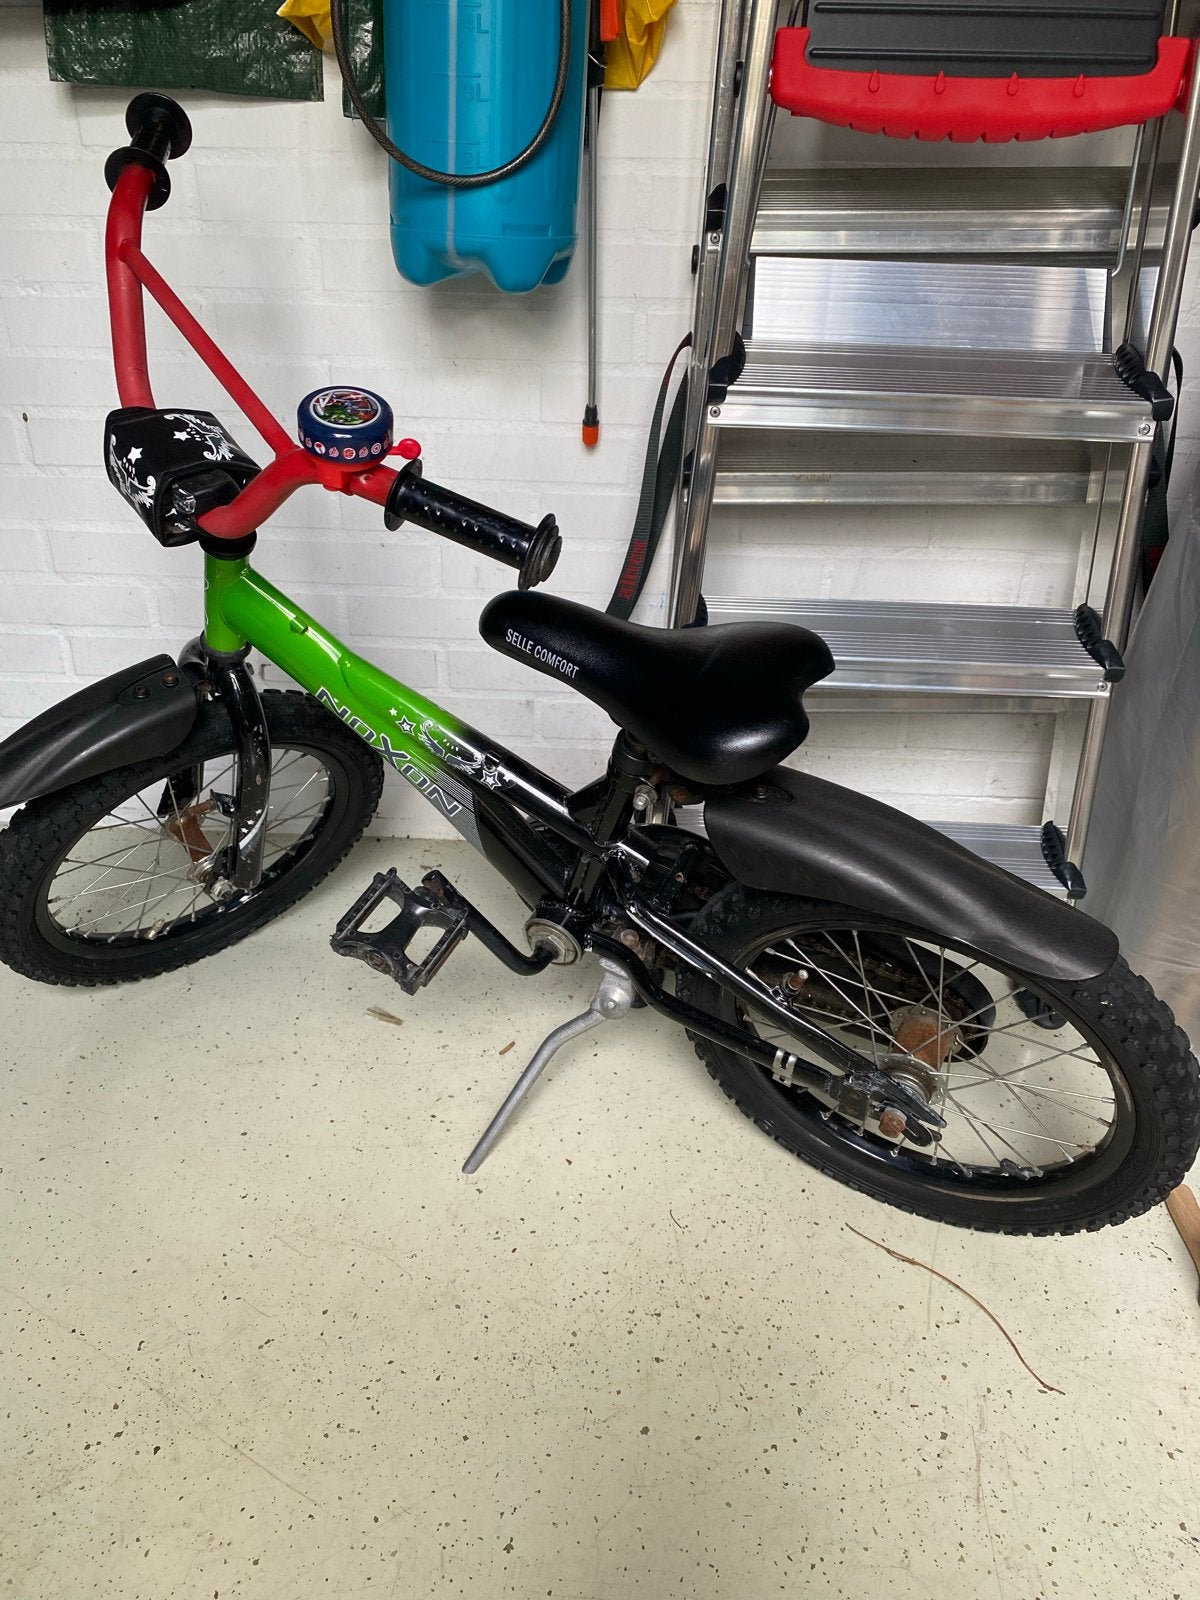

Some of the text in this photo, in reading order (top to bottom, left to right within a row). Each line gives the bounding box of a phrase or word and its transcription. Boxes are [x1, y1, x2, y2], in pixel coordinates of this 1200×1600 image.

[463, 13, 490, 34] 4L
[463, 82, 489, 103] 3L
[505, 628, 579, 679] SELLE COMFORT
[316, 687, 462, 817] NOXON
